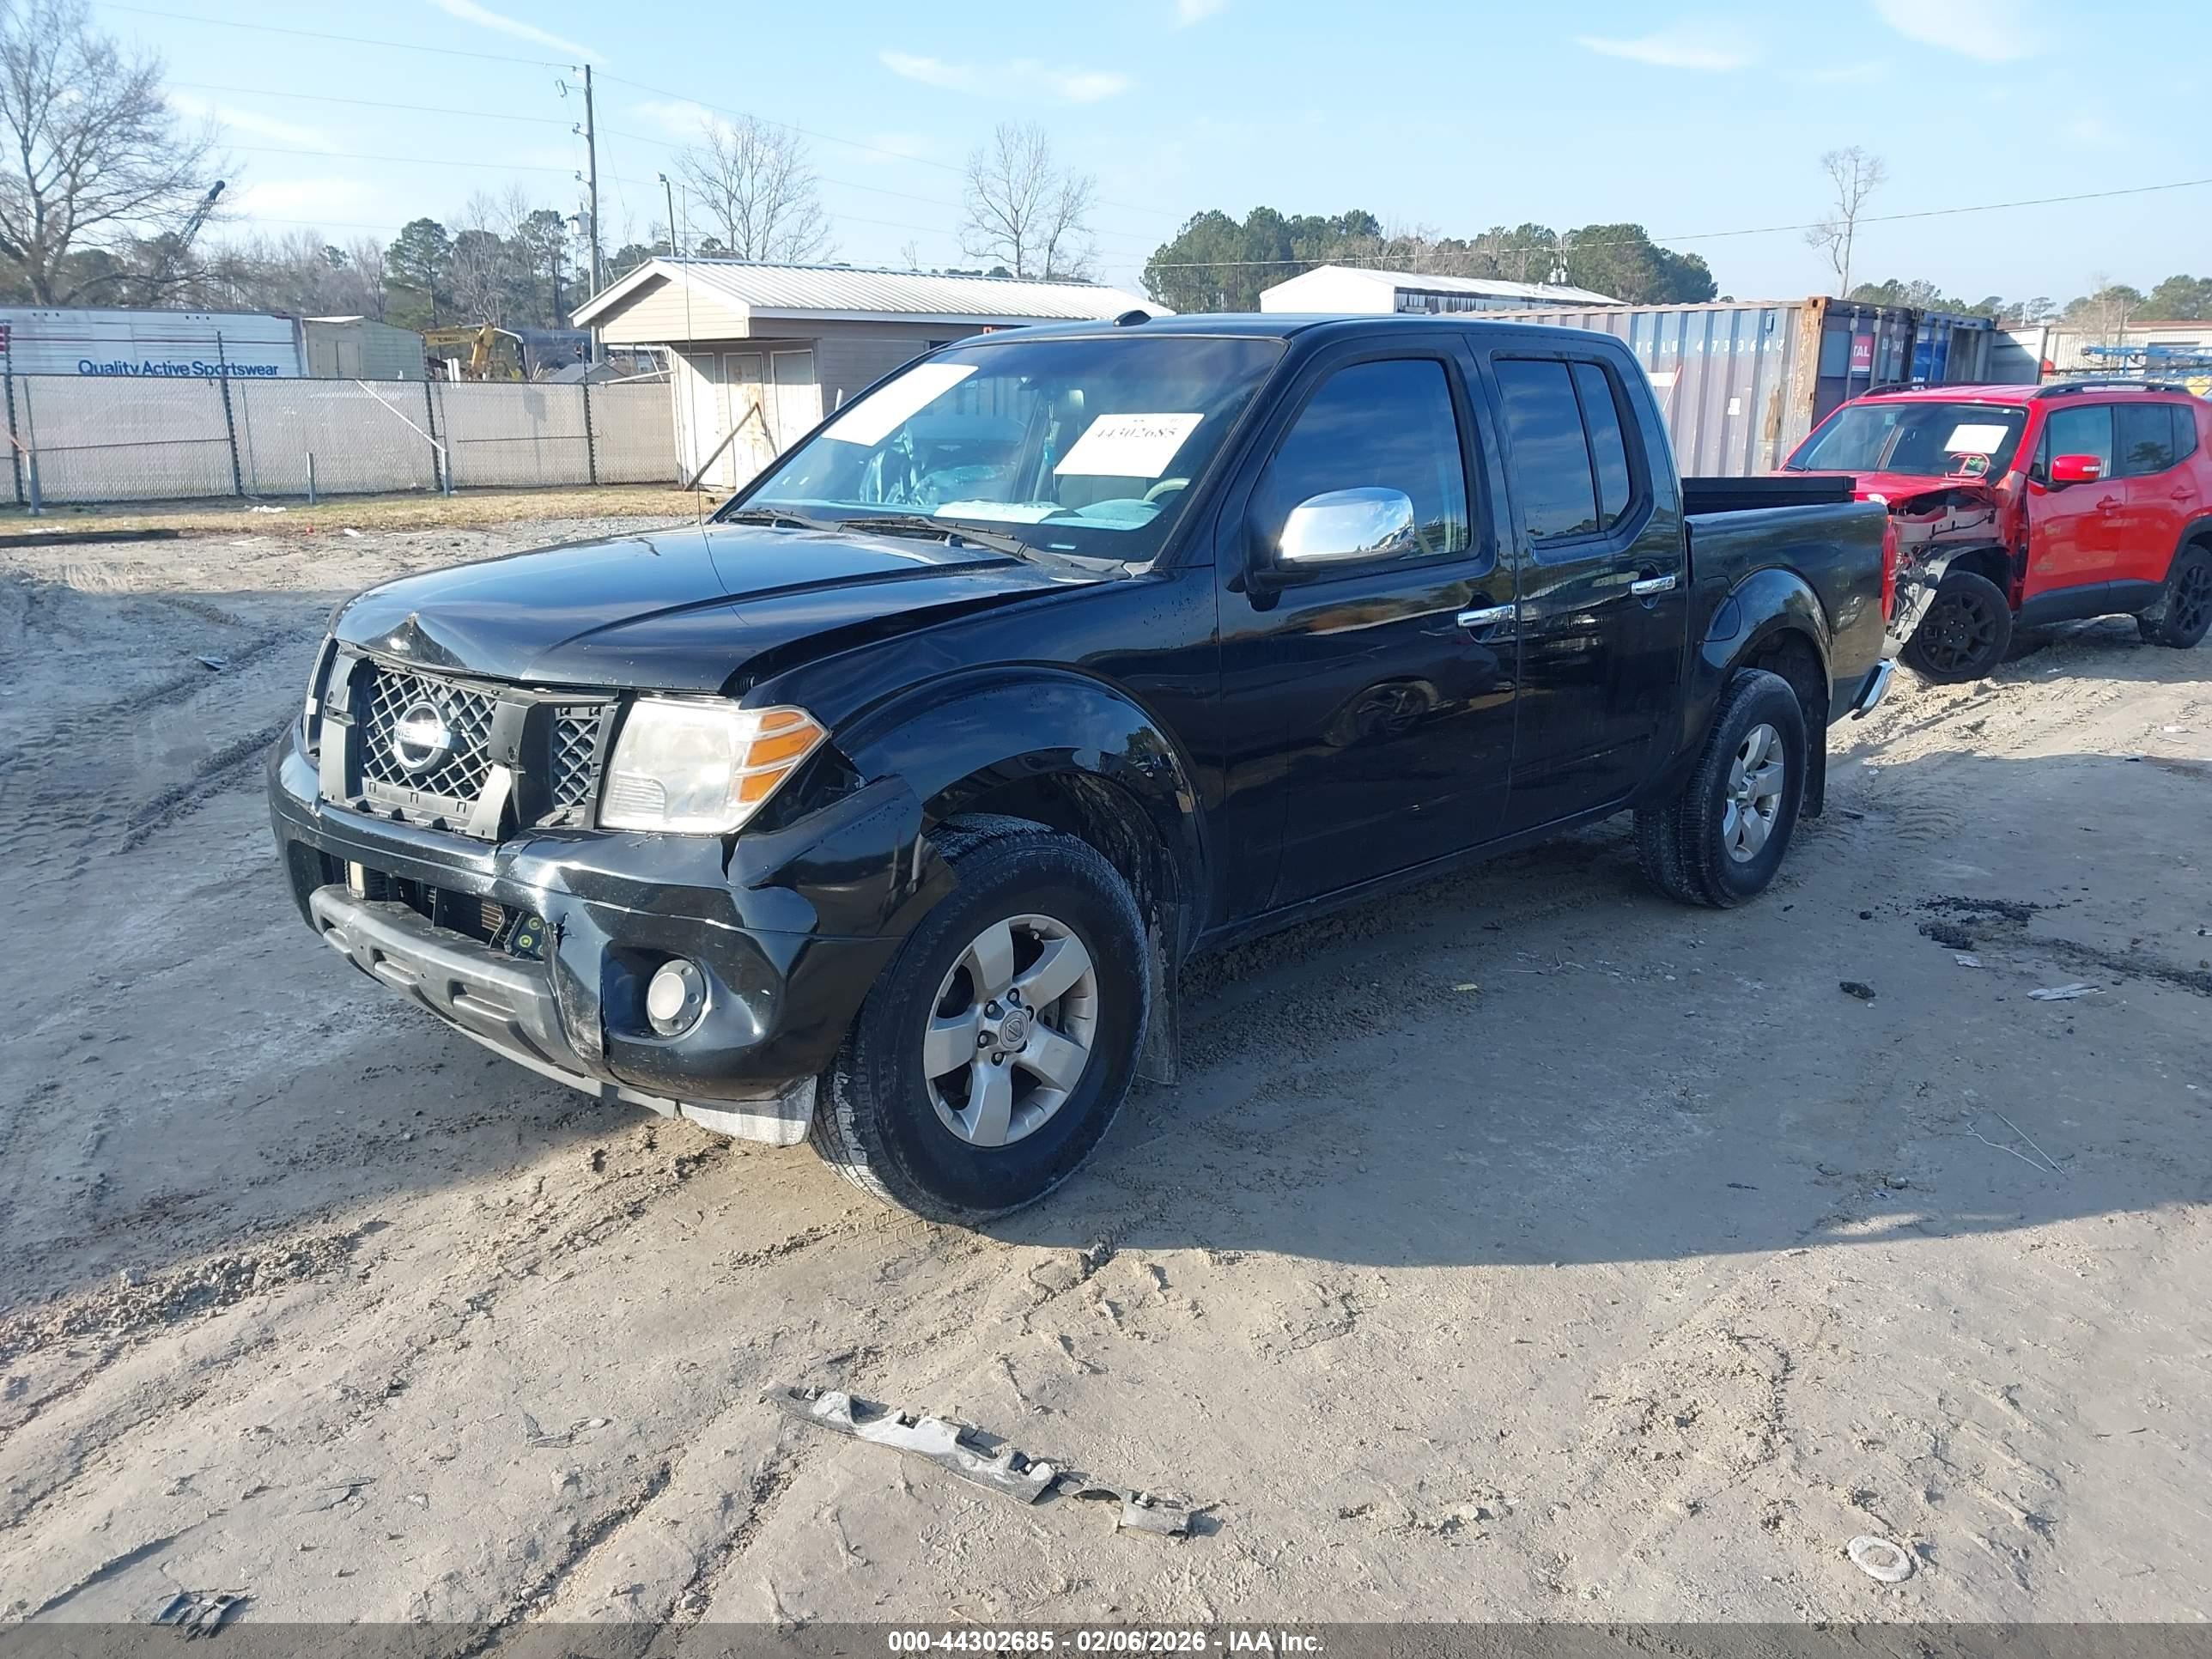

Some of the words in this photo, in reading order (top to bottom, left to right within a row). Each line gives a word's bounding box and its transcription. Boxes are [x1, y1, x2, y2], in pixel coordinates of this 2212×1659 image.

[1636, 340, 1679, 354] TCLU
[78, 360, 139, 376] Quality
[142, 361, 190, 376] Active
[191, 361, 278, 378] Sportswear
